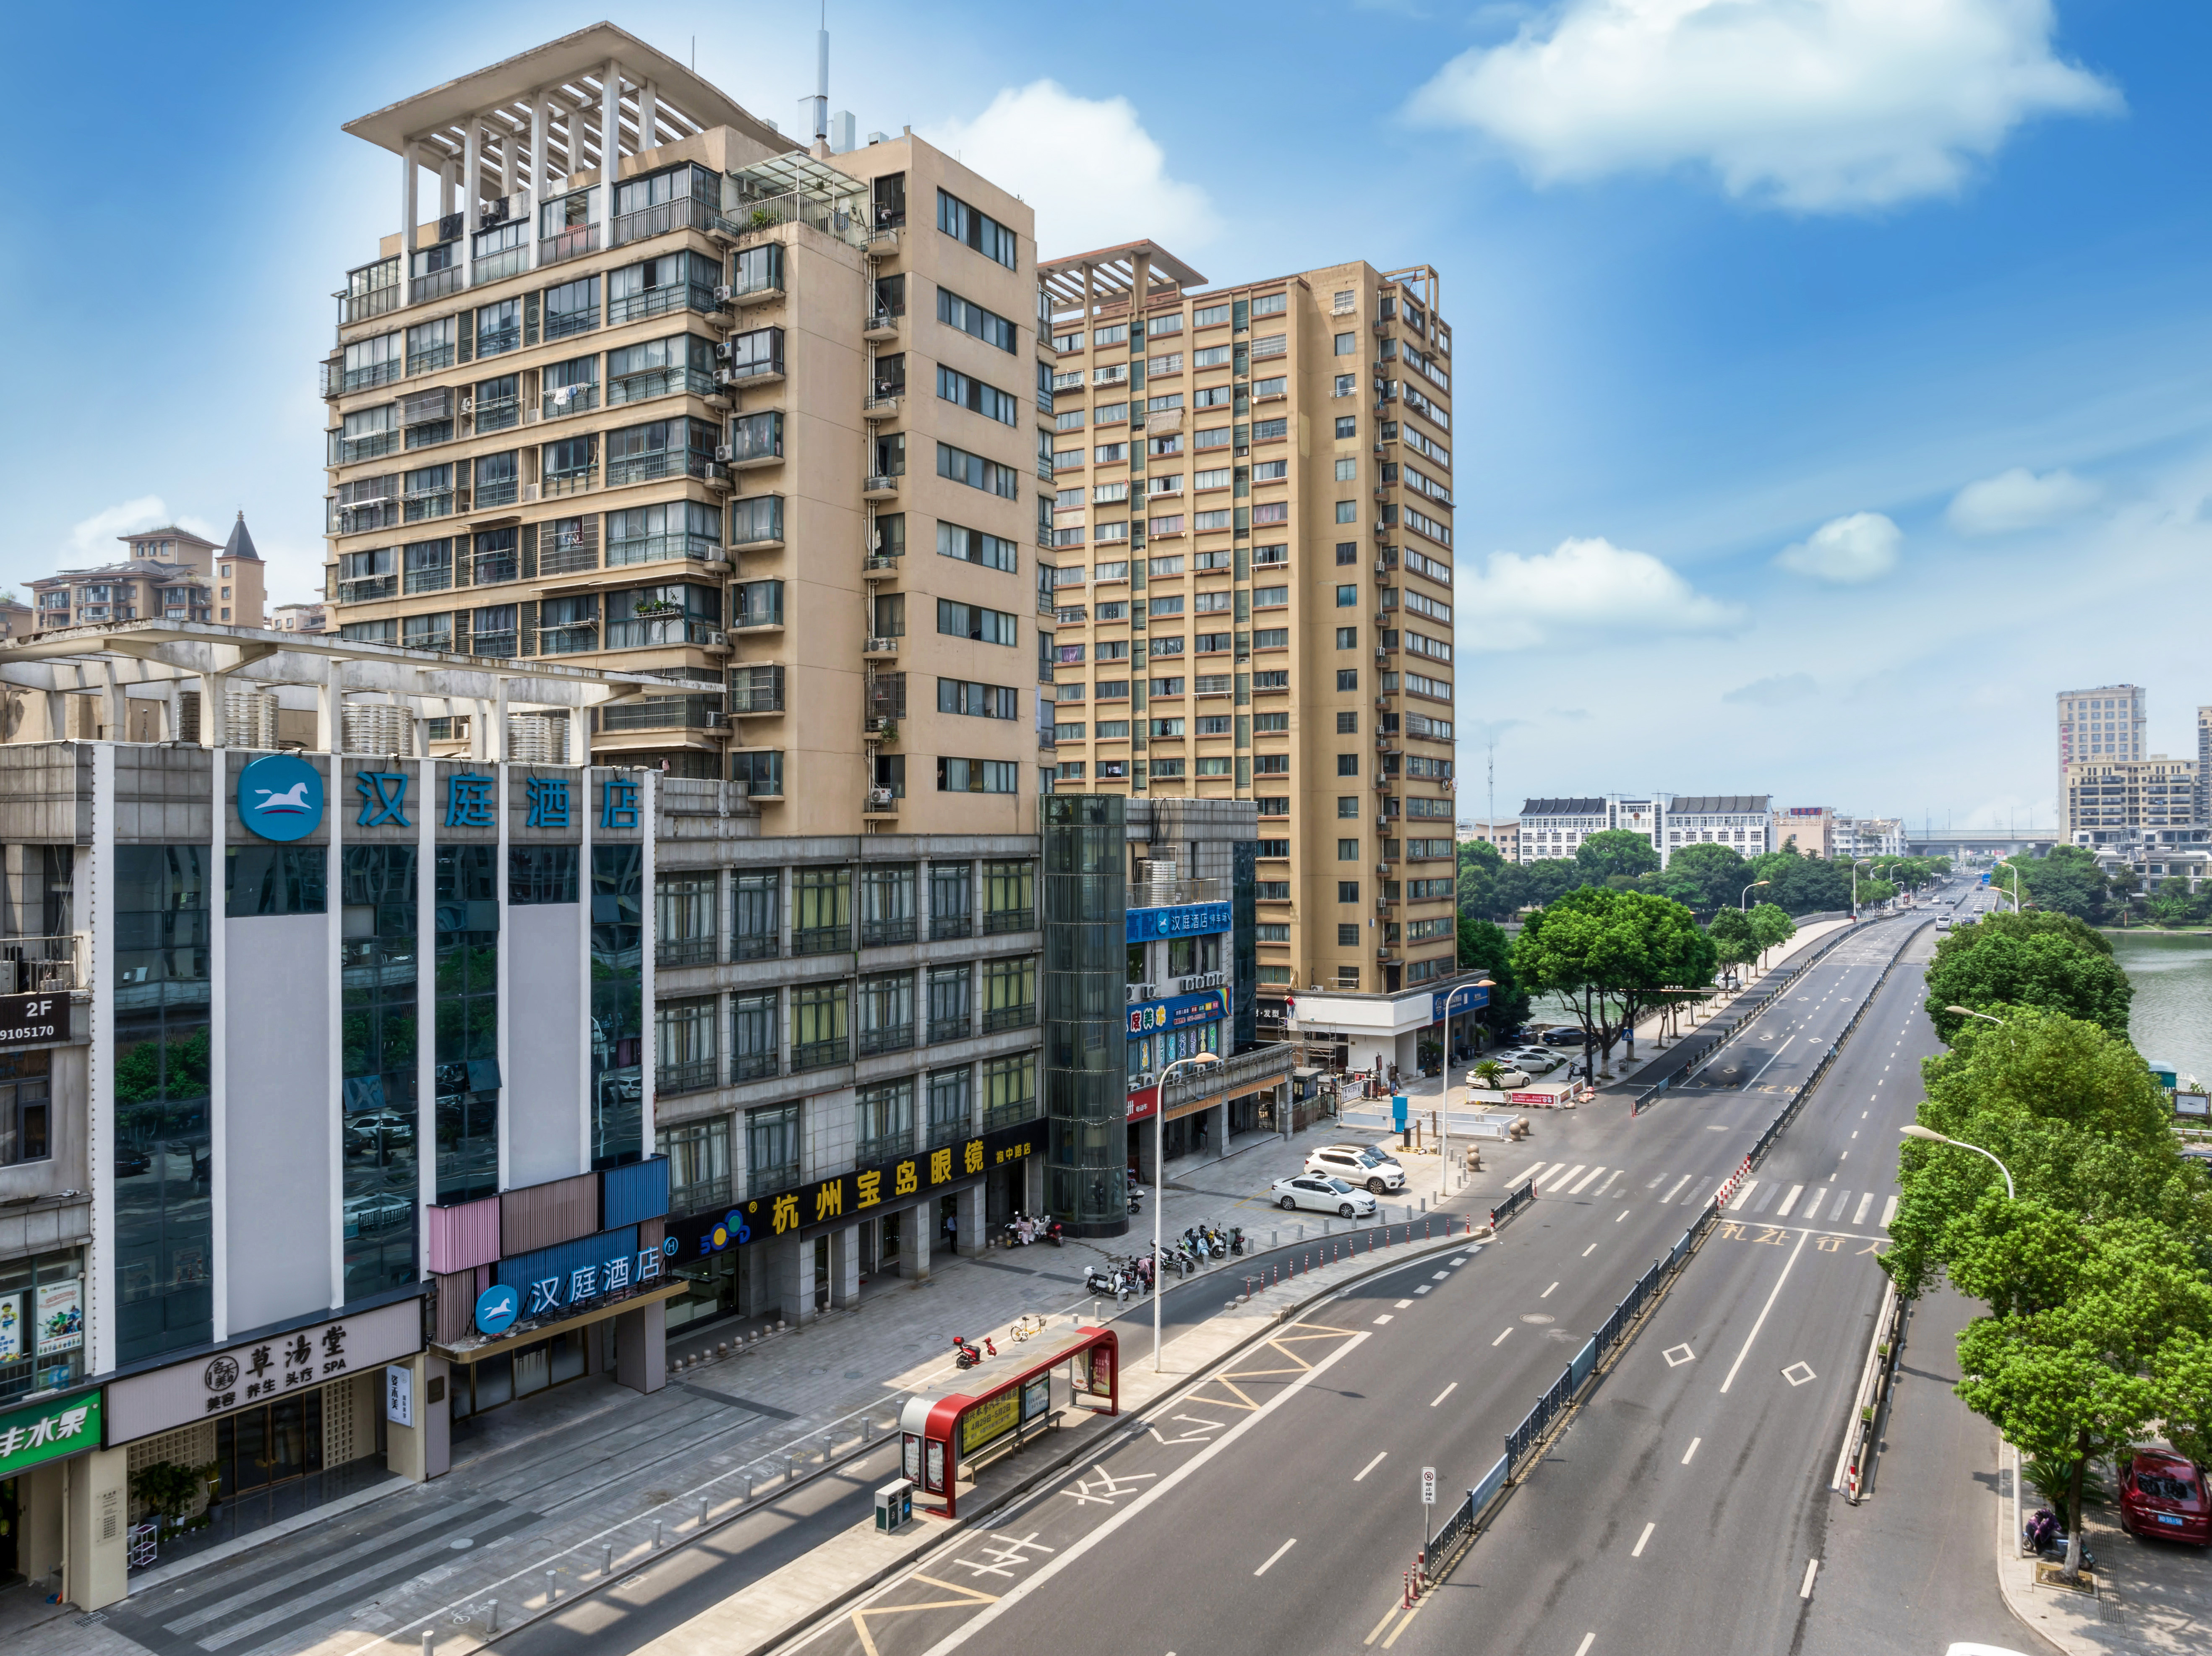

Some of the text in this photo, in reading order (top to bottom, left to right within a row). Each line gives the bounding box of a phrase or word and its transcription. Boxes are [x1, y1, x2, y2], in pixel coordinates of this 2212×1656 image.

[357, 771, 638, 828] 汉庭酒店
[1171, 913, 1207, 931] 汉庭酒店
[1210, 913, 1227, 924] 停车场
[26, 1000, 52, 1017] 2F
[1127, 1005, 1166, 1033] 度美术
[0, 1026, 54, 1040] 9105170
[1190, 1031, 1196, 1054] 速写
[1136, 1104, 1148, 1112] 电动车
[772, 1140, 984, 1234] 杭州宝岛眼镜
[1721, 1223, 1880, 1255] 礼让行人
[531, 1247, 659, 1313] 汉庭酒店
[207, 1359, 347, 1412] 美容 养生 头疗 SPA
